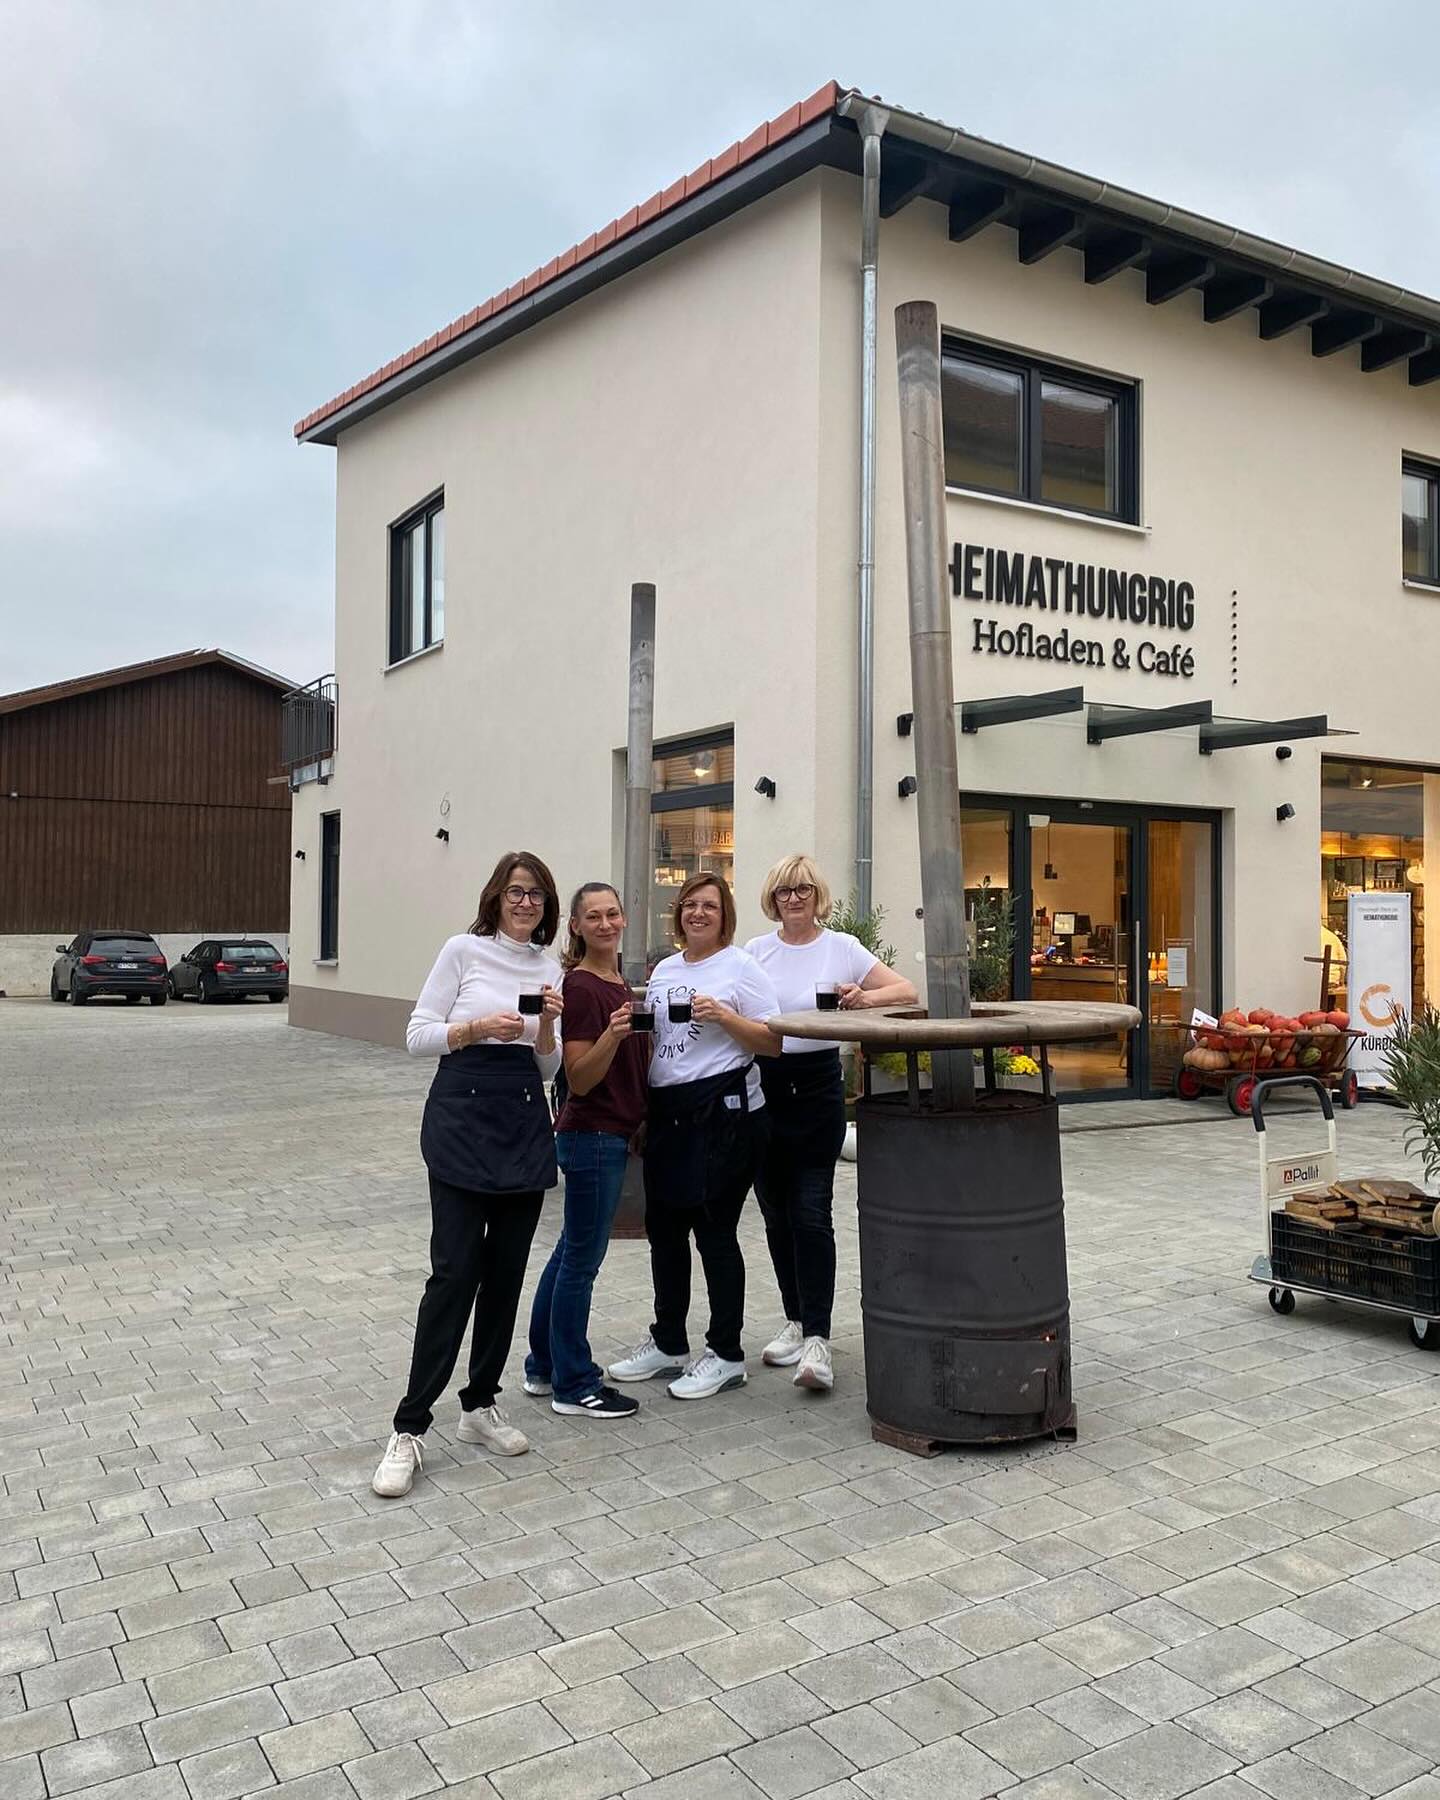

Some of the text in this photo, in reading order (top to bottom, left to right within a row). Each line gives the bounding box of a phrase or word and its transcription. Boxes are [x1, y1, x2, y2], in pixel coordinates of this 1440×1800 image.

[948, 542, 1195, 630] HEIMATHUNGRIG
[973, 618, 1195, 678] Hofladen & Café
